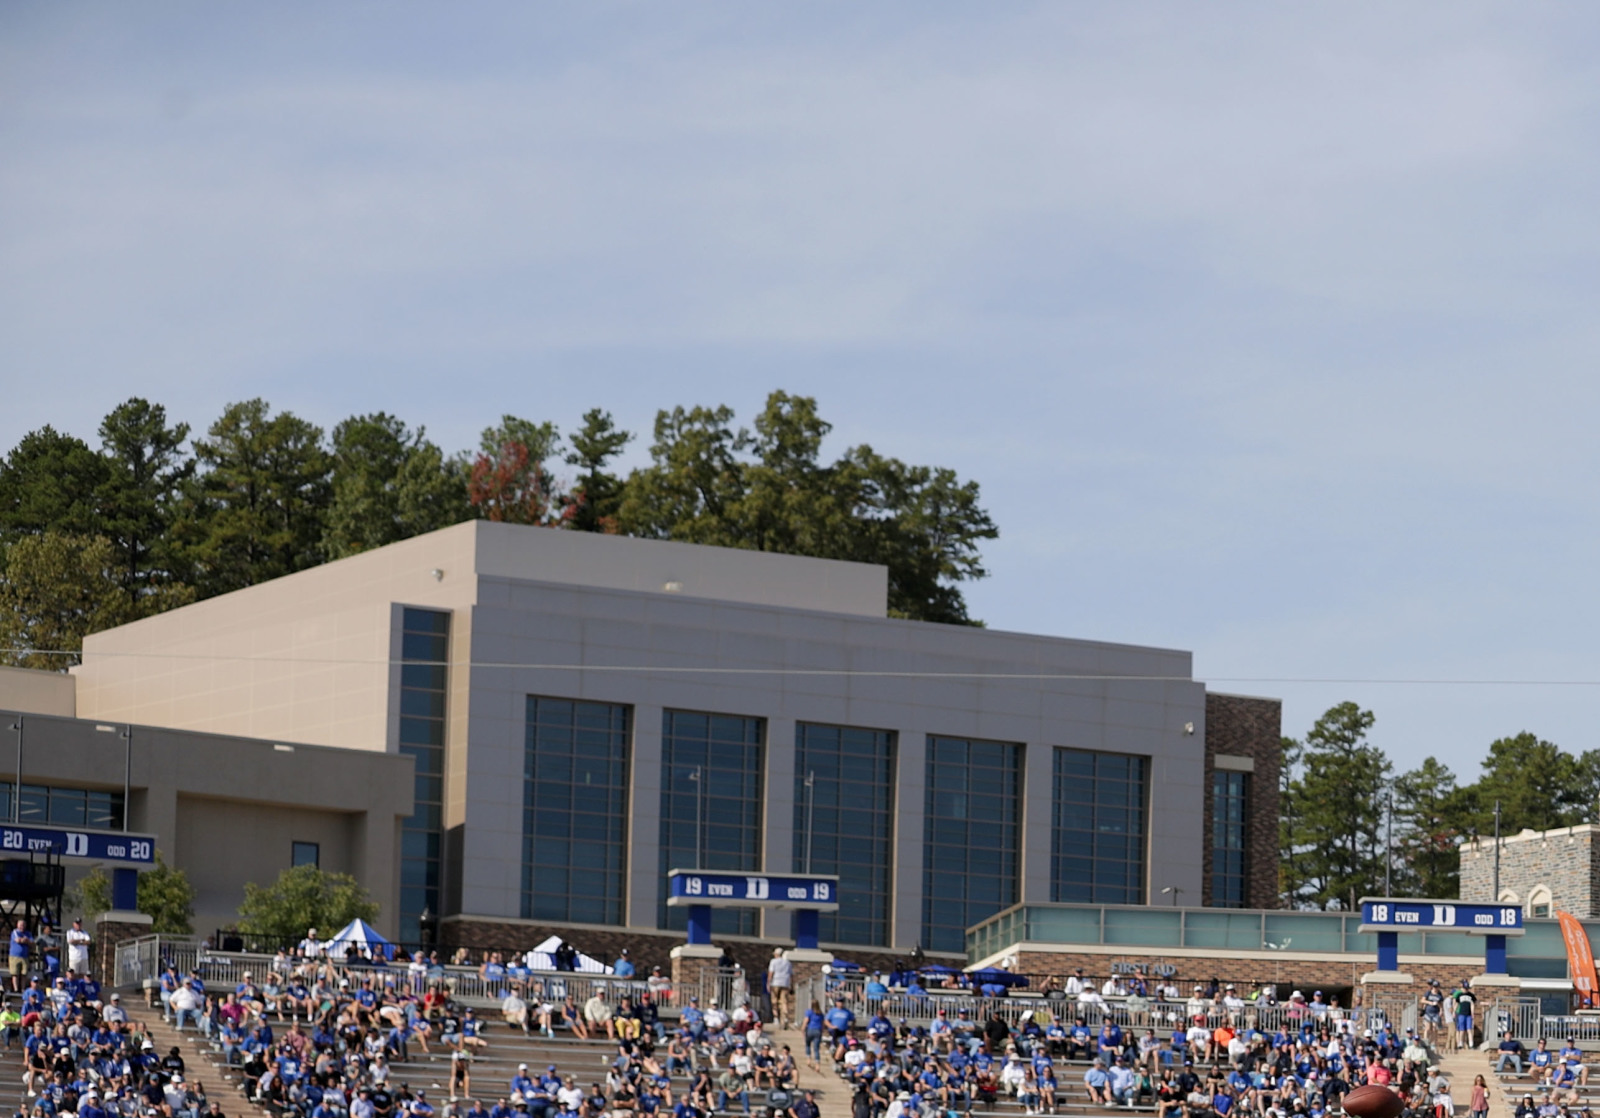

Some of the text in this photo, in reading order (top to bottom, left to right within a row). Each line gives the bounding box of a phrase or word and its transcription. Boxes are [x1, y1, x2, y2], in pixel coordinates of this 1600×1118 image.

[3, 830, 23, 849] 20
[28, 838, 53, 850] EVEN
[107, 845, 126, 857] ODD
[130, 841, 150, 859] 20
[685, 876, 702, 895] 19
[708, 883, 734, 896] EVEN
[787, 887, 807, 899] ODD
[813, 883, 830, 900] 19
[1372, 904, 1388, 922] 18
[1395, 911, 1420, 923] EVEN
[1475, 914, 1494, 925] ODD
[1500, 908, 1516, 926] 18
[1110, 962, 1176, 975] FIRST AID
